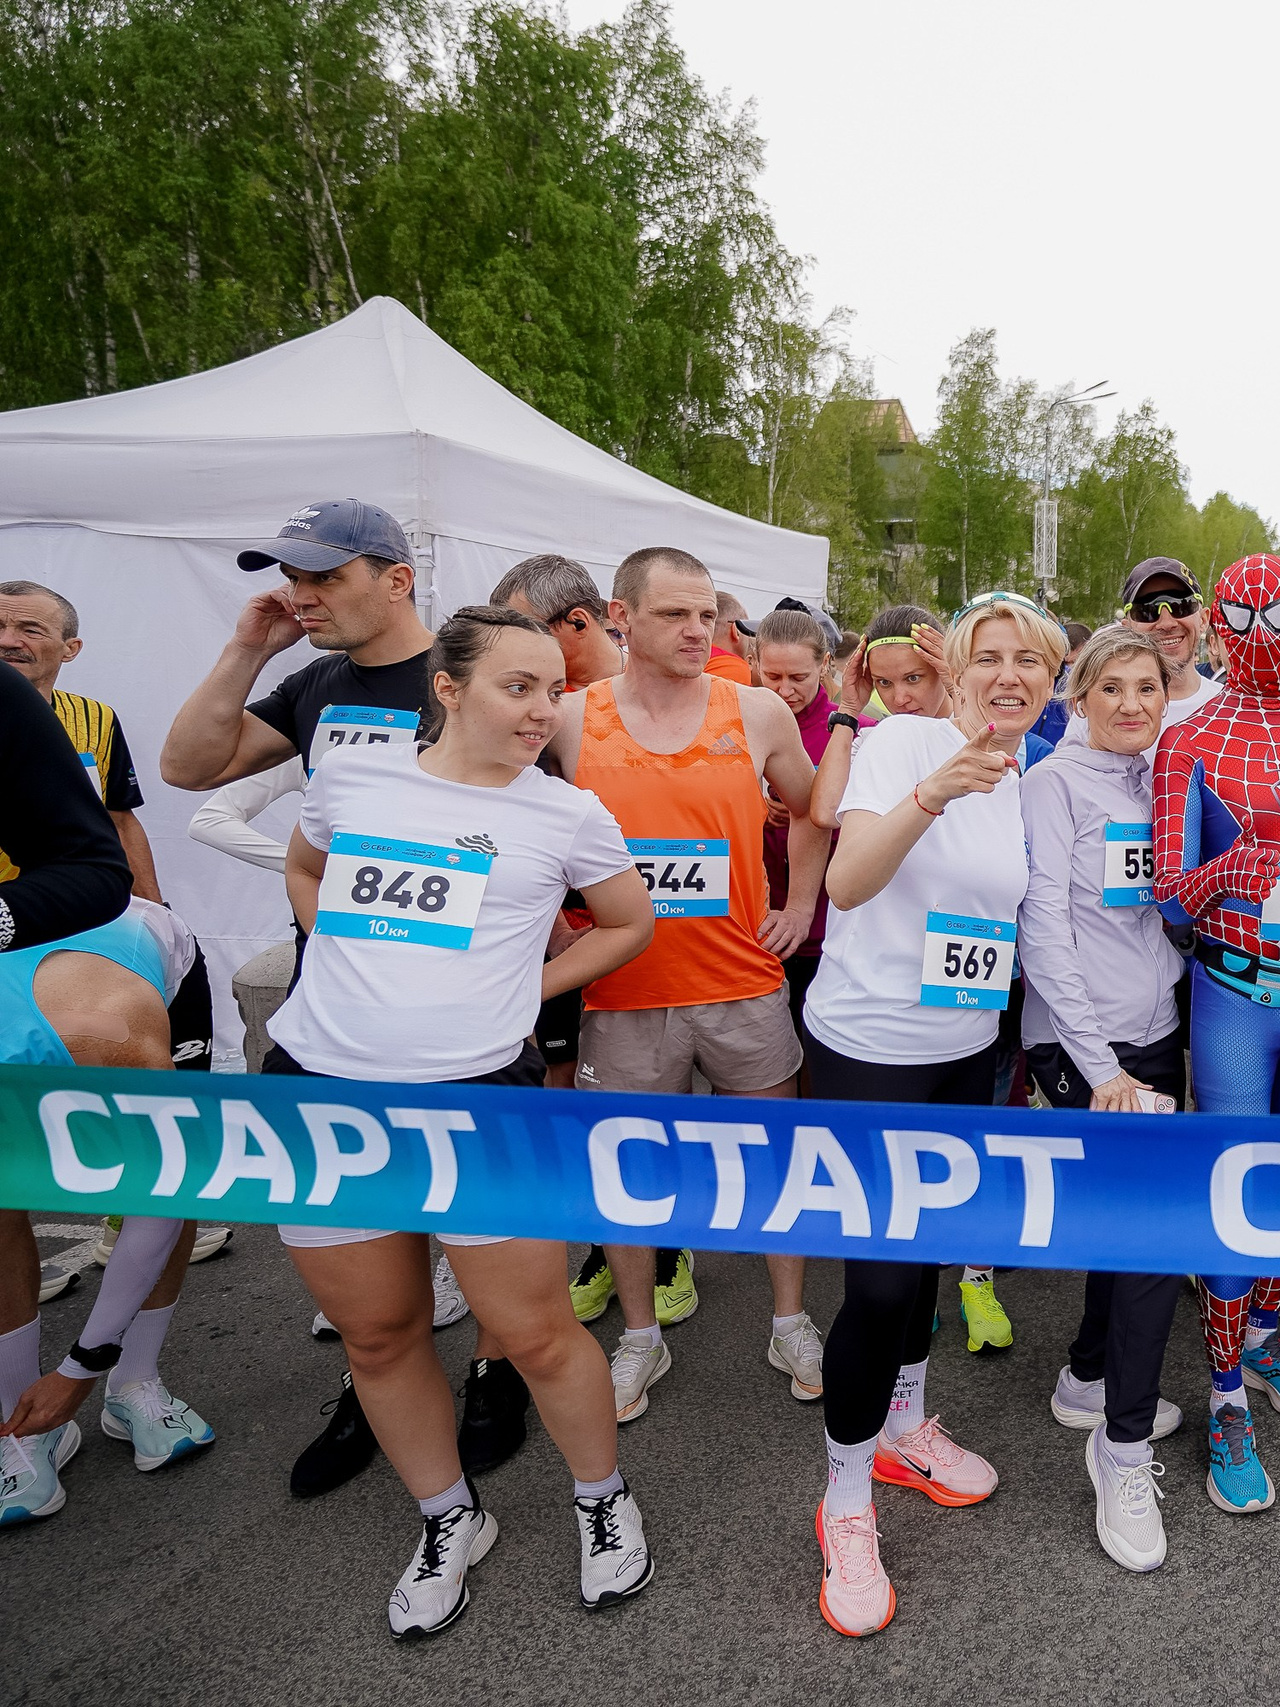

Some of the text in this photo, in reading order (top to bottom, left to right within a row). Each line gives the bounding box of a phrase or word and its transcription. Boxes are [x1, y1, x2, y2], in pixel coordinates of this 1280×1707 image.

[371, 844, 392, 852] СБЕР
[351, 865, 450, 913] 848
[634, 862, 706, 893] 544
[944, 942, 998, 981] 569
[38, 1090, 477, 1213] СТАРТ
[588, 1116, 1085, 1248] СТАРТ
